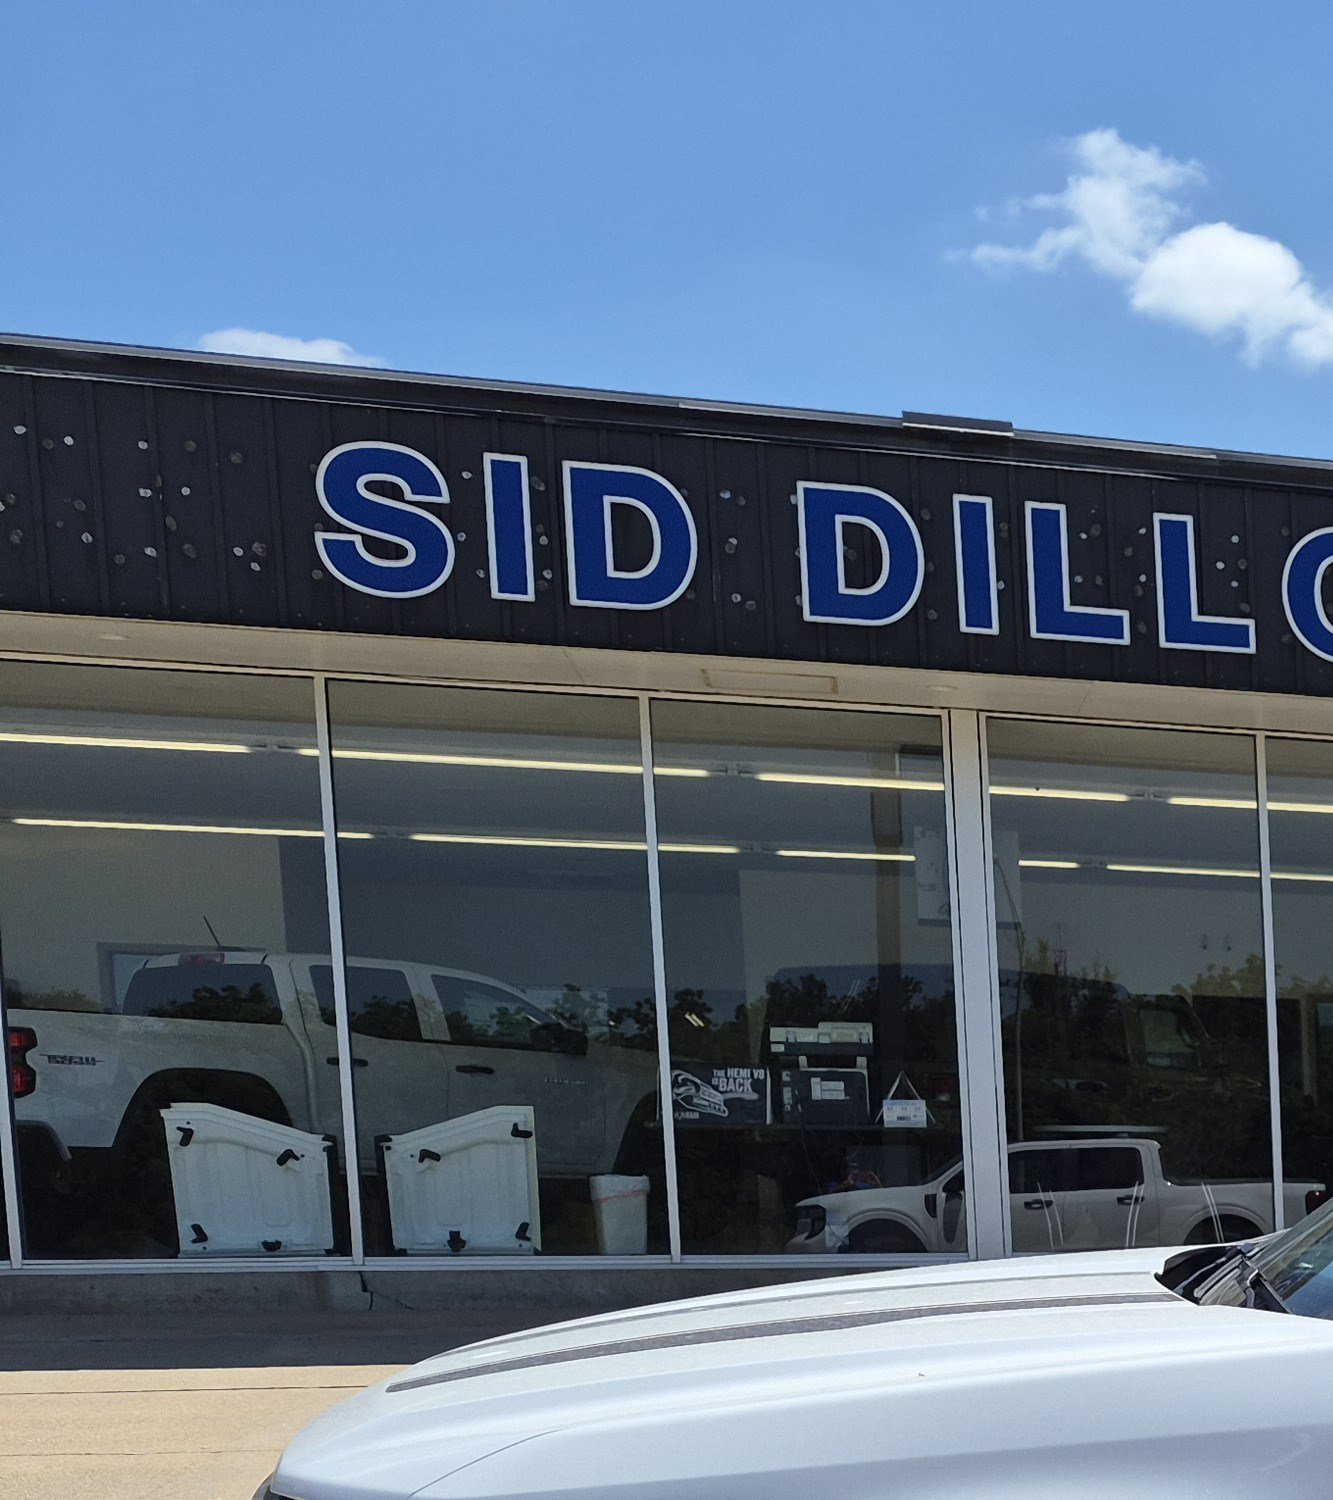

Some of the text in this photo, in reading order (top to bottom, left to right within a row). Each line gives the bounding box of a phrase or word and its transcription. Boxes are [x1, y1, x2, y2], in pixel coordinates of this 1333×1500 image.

[314, 440, 698, 610] SID
[727, 1068, 751, 1078] HEMI
[753, 1069, 765, 1080] V8
[719, 1078, 752, 1092] BACK
